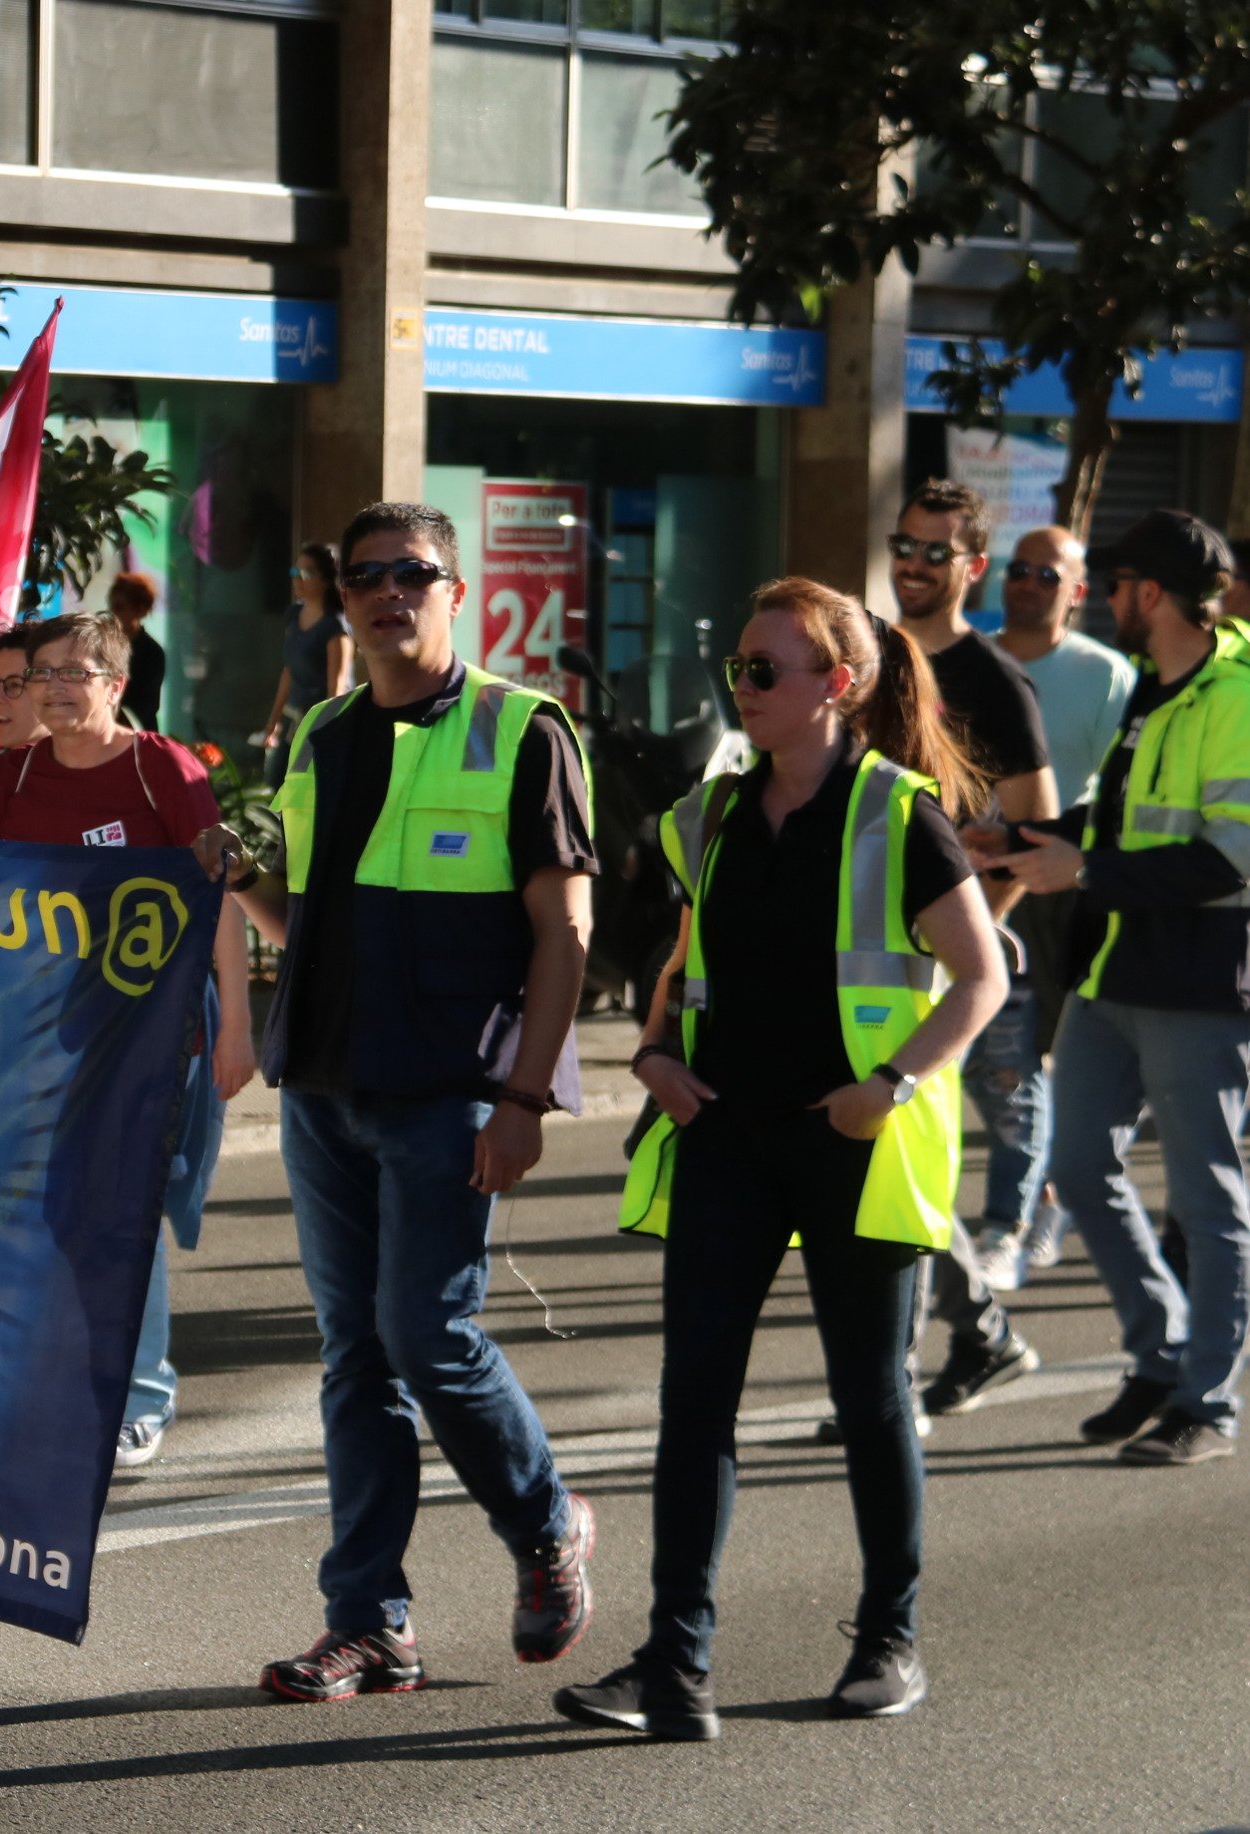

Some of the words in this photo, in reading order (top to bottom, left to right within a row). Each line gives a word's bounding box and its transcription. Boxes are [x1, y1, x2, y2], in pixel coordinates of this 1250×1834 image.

[239, 316, 299, 342] Sanitas
[473, 325, 549, 353] DENTAL
[486, 587, 566, 673] 24
